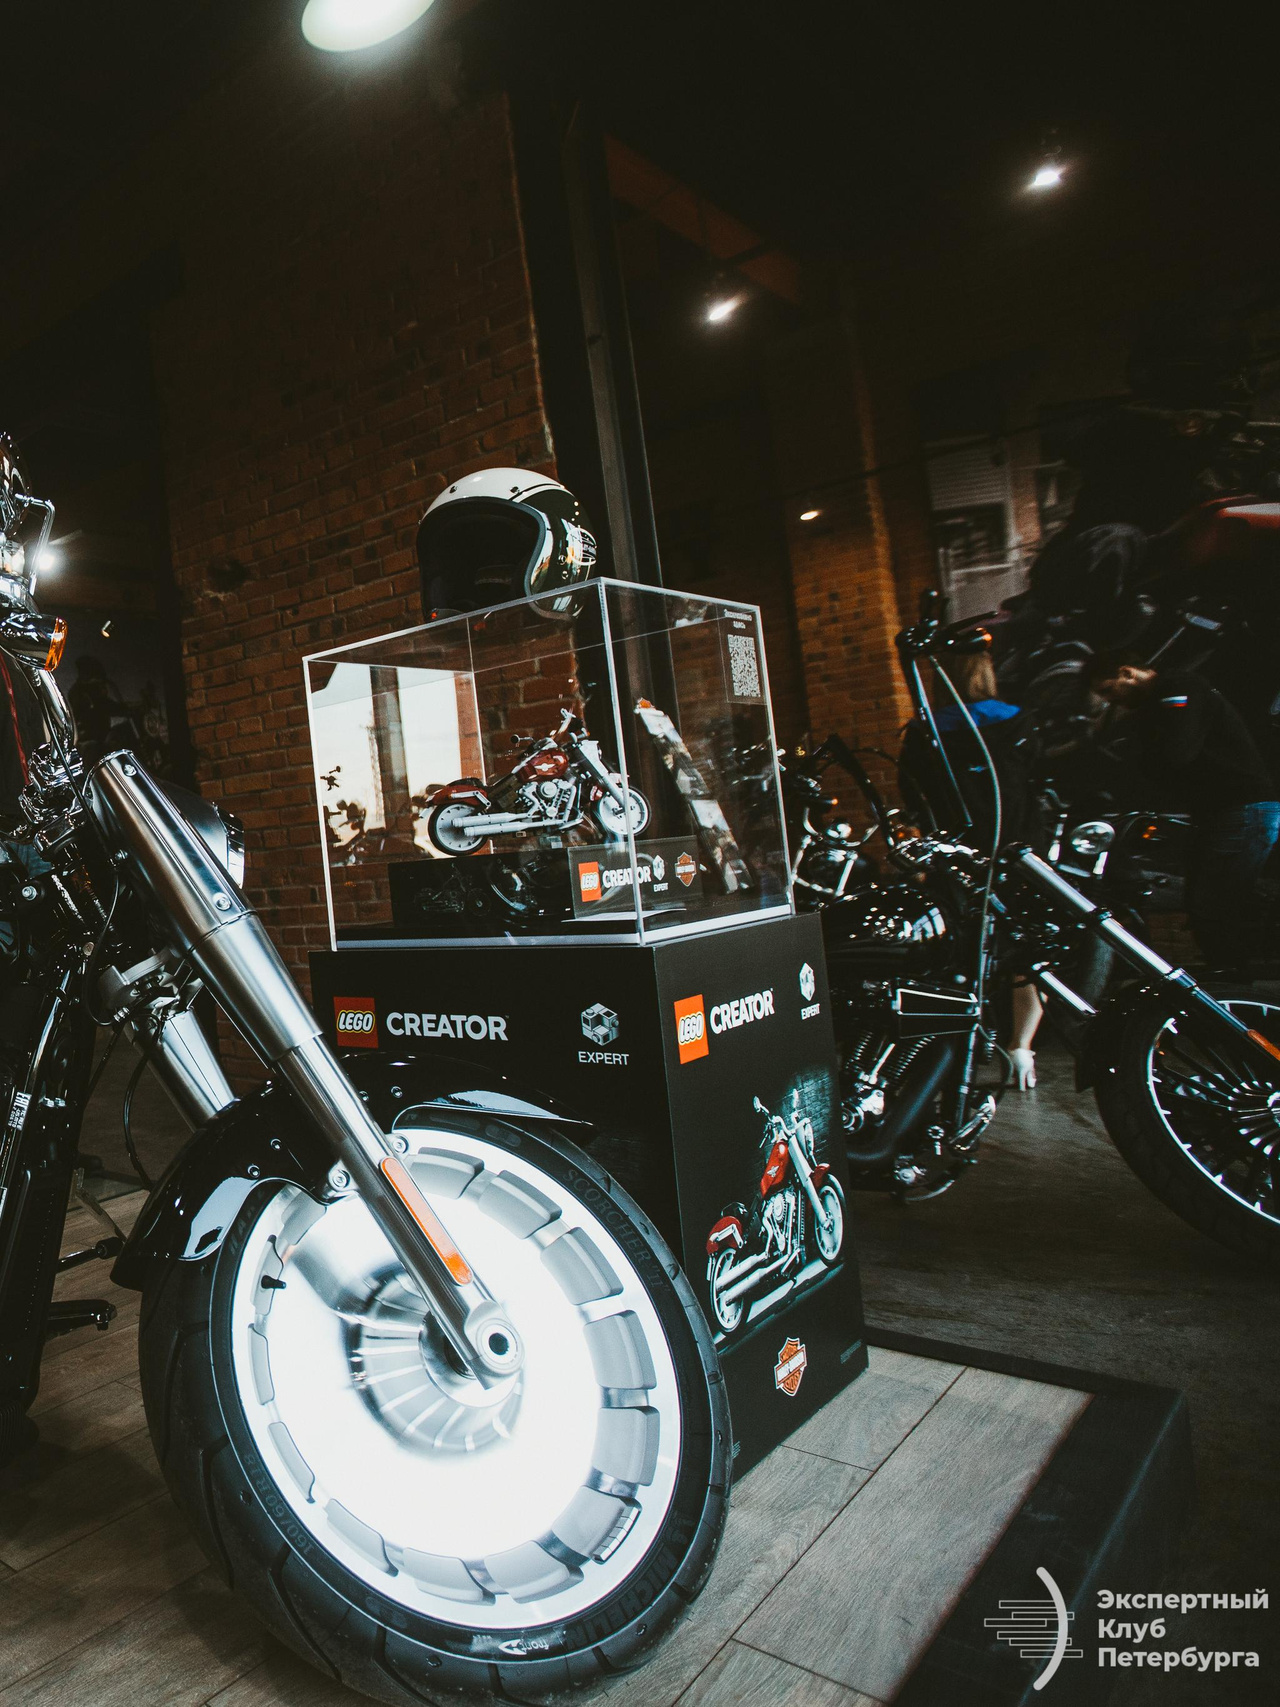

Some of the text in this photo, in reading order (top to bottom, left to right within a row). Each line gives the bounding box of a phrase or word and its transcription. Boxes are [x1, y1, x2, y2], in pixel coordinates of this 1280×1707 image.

[581, 872, 600, 891] LEGO
[679, 989, 775, 1044] LEGO CREATOR
[801, 1003, 820, 1020] EXPERT
[338, 1010, 508, 1041] LEGO CREATOR
[578, 1051, 630, 1066] EXPERT
[563, 1168, 652, 1264] SCORCHER
[570, 1549, 680, 1651] MICHELIN
[519, 1638, 550, 1652] front
